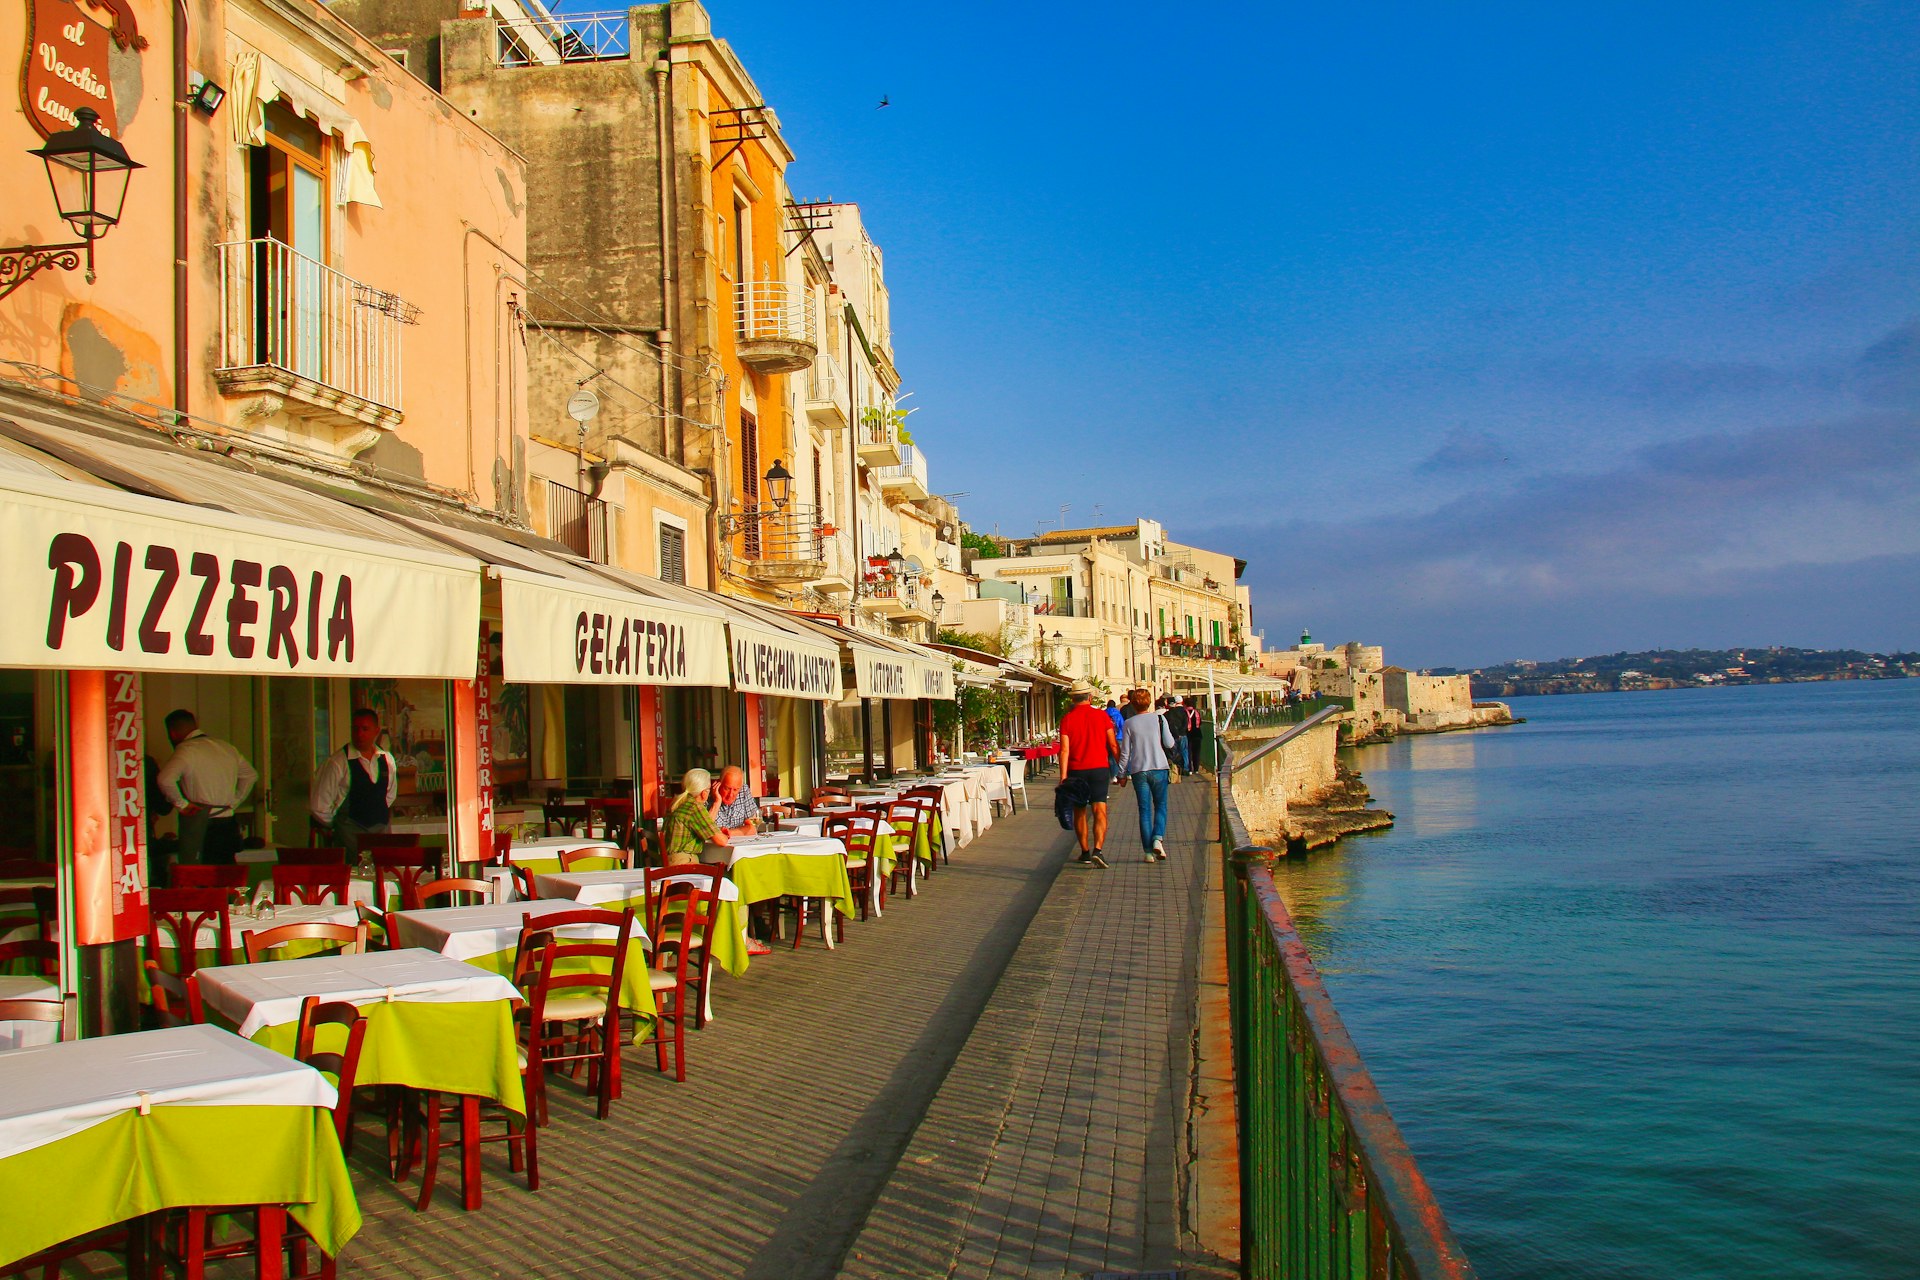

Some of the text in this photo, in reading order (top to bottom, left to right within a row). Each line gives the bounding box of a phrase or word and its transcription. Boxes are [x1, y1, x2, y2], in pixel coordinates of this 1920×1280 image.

[63, 21, 85, 46] al
[38, 42, 107, 100] Vecchio
[38, 86, 110, 138] lavaio
[46, 532, 355, 669] PIZZERIA
[575, 611, 686, 681] GELATERIA
[737, 638, 750, 685] AL
[753, 643, 796, 691] VECCHIO
[478, 637, 493, 832] GELATERIA
[655, 685, 665, 797] STORANTE
[113, 673, 143, 896] ZZERIA
